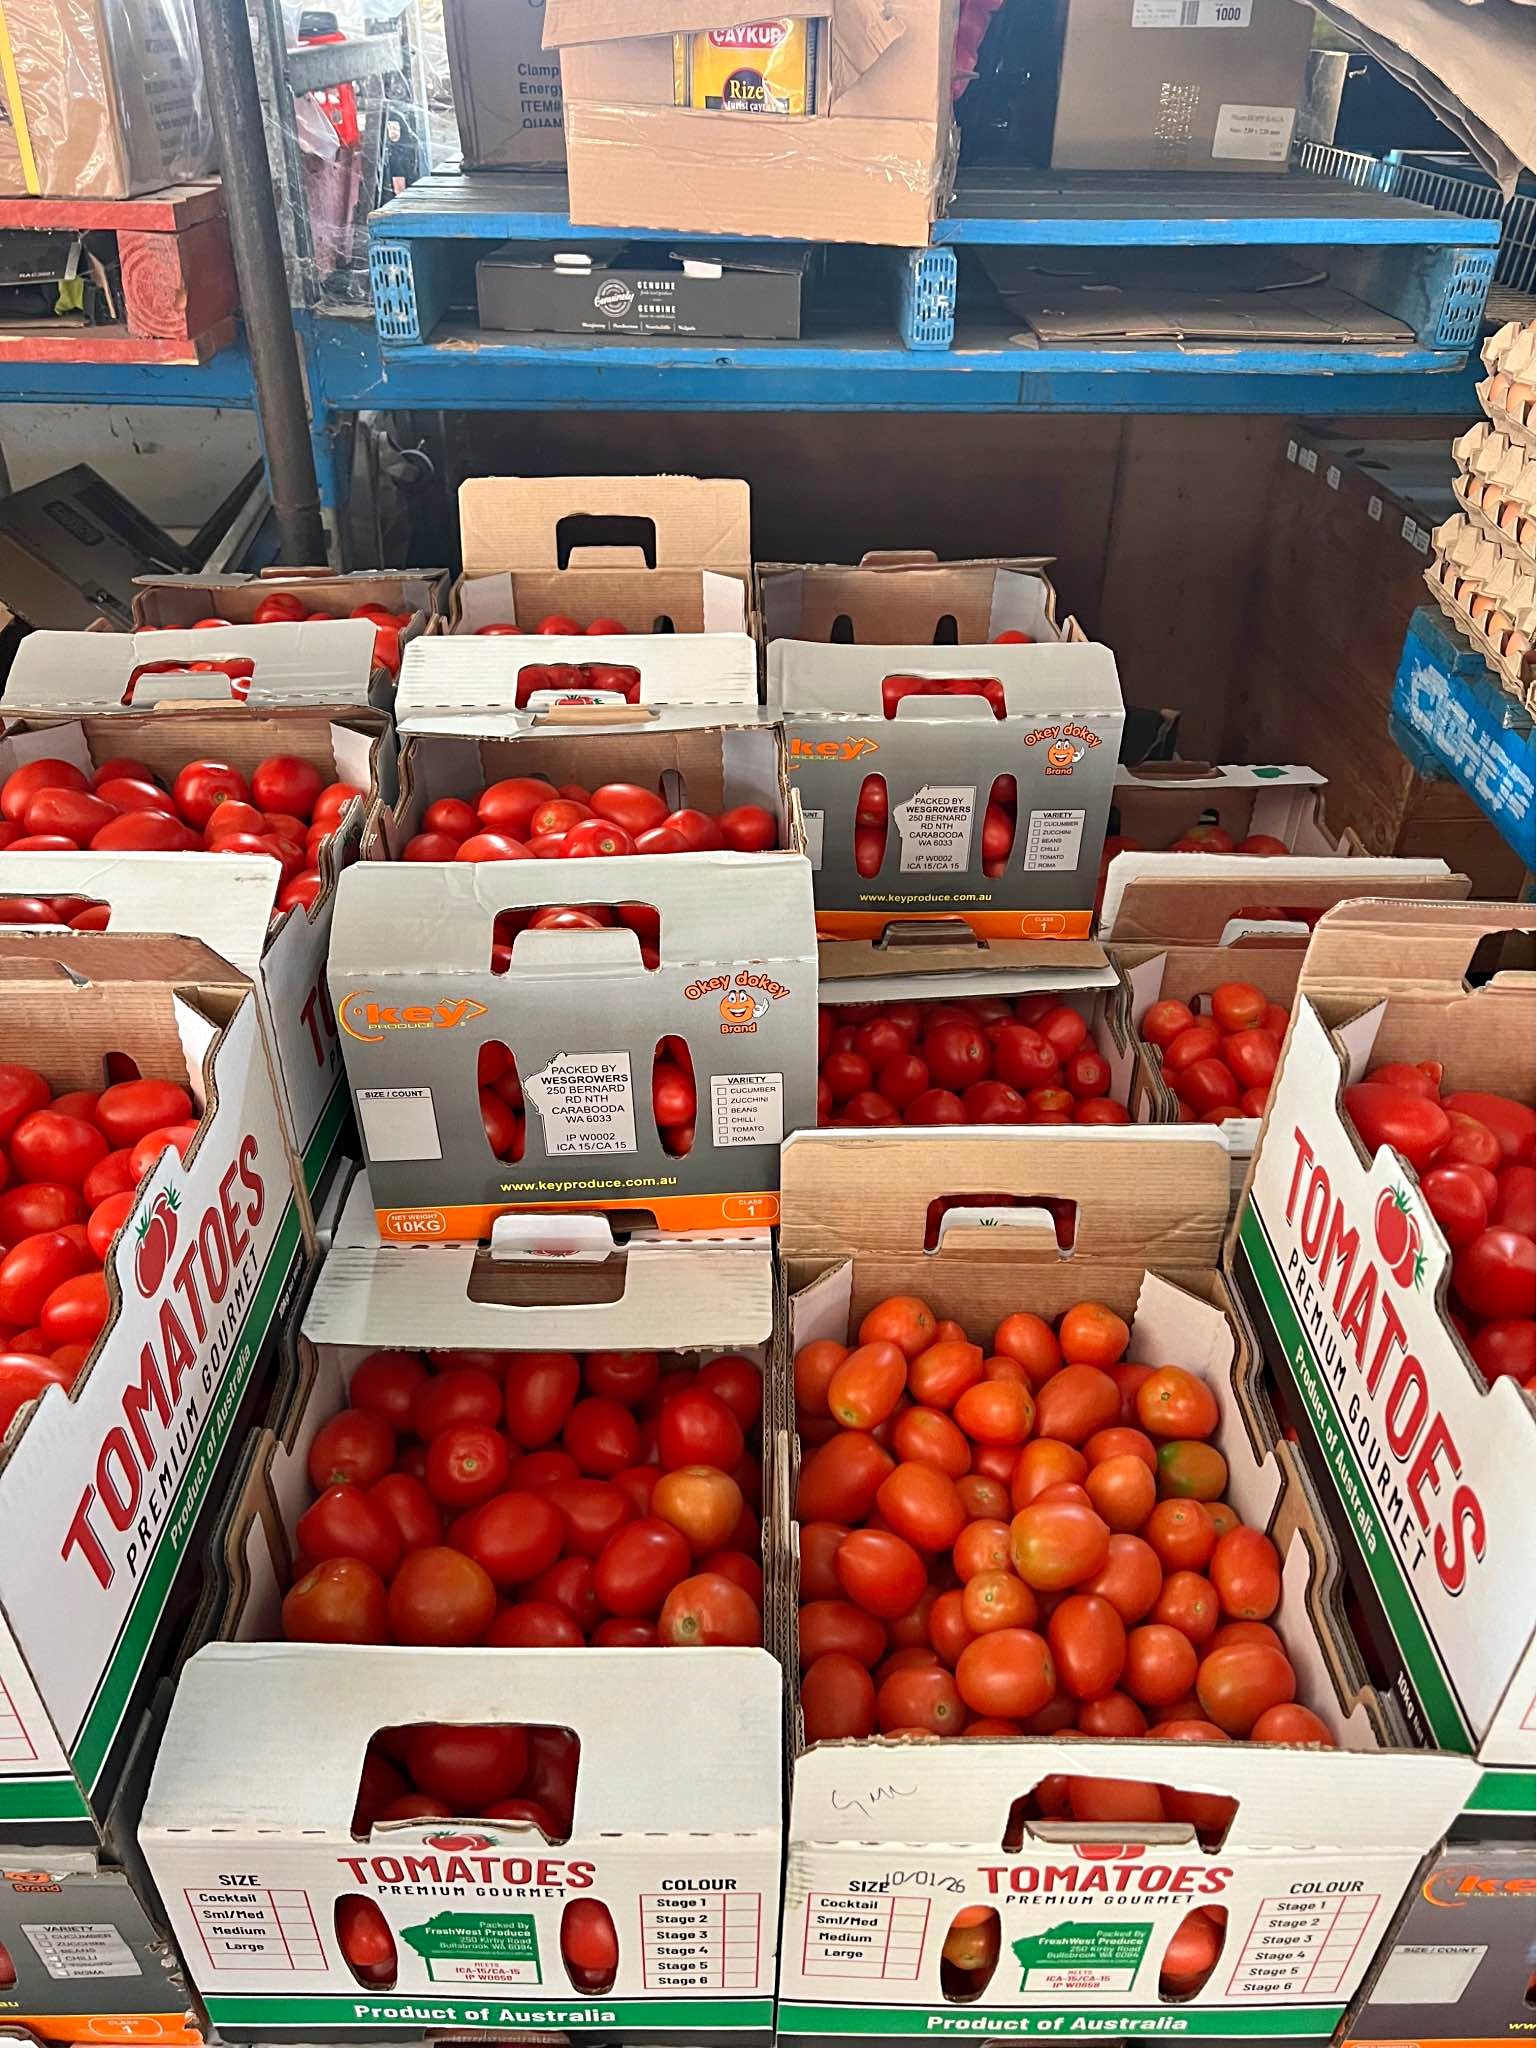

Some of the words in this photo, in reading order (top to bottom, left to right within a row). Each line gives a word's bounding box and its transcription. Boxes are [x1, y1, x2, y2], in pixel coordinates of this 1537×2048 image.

[1215, 7, 1241, 21] 1000
[517, 63, 560, 78] Clamp
[729, 79, 764, 99] Rize
[637, 281, 676, 290] GENUINE
[638, 304, 677, 313] GENUINE
[1023, 725, 1060, 746] Okey
[1063, 722, 1103, 748] dokey
[790, 738, 866, 762] key
[1044, 766, 1074, 776] Brand
[915, 797, 950, 805] PACKED
[906, 806, 971, 814] WESGROWERS
[908, 814, 923, 822] 250
[925, 814, 967, 822] BERNARD
[920, 822, 934, 830] RD
[935, 822, 953, 830] NTH
[909, 831, 964, 839] CARABOODA
[859, 893, 993, 904] www.keyproduce.com.au
[1040, 922, 1047, 932] 1
[684, 975, 731, 1001] Okey
[735, 970, 791, 1001] dokey
[365, 1001, 470, 1030] key
[720, 1021, 758, 1034] Brand
[551, 1065, 598, 1075] PACKED
[601, 1064, 617, 1073] BY
[540, 1073, 629, 1085] WESGROWERS
[727, 1076, 767, 1085] VARIETY
[364, 1091, 385, 1099] SIZE
[393, 1090, 424, 1098] COUNT
[546, 1086, 566, 1095] 250
[569, 1084, 625, 1094] BERNARD
[730, 1086, 777, 1095] CUCUMBER
[565, 1095, 582, 1104] RD
[585, 1094, 609, 1103] NTH
[730, 1096, 769, 1104] ZUCCHINI
[551, 1104, 625, 1115] CARABOODA
[730, 1106, 758, 1114] BEANS
[565, 1115, 585, 1124] WA
[586, 1114, 612, 1123] 6033
[731, 1125, 765, 1133] TOMATO
[579, 1132, 616, 1141] W0002
[731, 1135, 756, 1143] ROMA
[556, 1143, 576, 1151] ICA
[578, 1142, 612, 1151] 15/CA
[614, 1141, 627, 1149] 15
[500, 1176, 678, 1192] www.keyproduce.com.au
[747, 1205, 755, 1217] 1
[407, 1213, 438, 1221] WEIGHT
[392, 1220, 441, 1233] 10KG
[61, 1134, 266, 1591] TOMATOES
[1281, 1125, 1487, 1598] TOMATOES
[126, 1396, 200, 1578] PREMIUM
[202, 1243, 260, 1395] GOURMET
[1288, 1247, 1347, 1392] PREMIUM
[1348, 1393, 1427, 1573] GOURMET
[170, 1454, 208, 1551] Product
[206, 1424, 218, 1457] of
[214, 1343, 251, 1436] Australia
[1295, 1344, 1328, 1430] Product
[1325, 1425, 1339, 1452] of
[1334, 1447, 1377, 1555] Australia
[1397, 1670, 1415, 1719] 10kg
[336, 1855, 597, 1889] TOMATOES
[217, 1874, 262, 1886] SIZE
[661, 1878, 737, 1891] COLOUR
[885, 1870, 966, 1894] 10/01/26
[976, 1865, 1235, 1894] TOMATOES
[13, 1883, 62, 1893] Brand
[377, 1885, 465, 1896] PREMIUM
[476, 1887, 567, 1898] GOURMET
[848, 1880, 890, 1893] SIZE
[1289, 1880, 1365, 1895] COLOUR
[199, 1893, 257, 1903] Cocktail
[656, 1898, 697, 1909] Stage
[700, 1898, 706, 1907] 1
[1005, 1895, 1094, 1905] PREMIUM
[1103, 1894, 1196, 1905] GOURMET
[820, 1898, 878, 1910] Cocktail
[1276, 1902, 1316, 1912] Stage
[1320, 1901, 1327, 1910] 1
[202, 1910, 265, 1920] Sml/Med
[656, 1915, 696, 1925] Stage
[698, 1914, 709, 1923] 2
[479, 1922, 516, 1930] Packed
[516, 1922, 530, 1931] By
[816, 1915, 878, 1927] Sml/Med
[1268, 1919, 1308, 1929] Stage
[1310, 1918, 1321, 1927] 2
[212, 1926, 266, 1936] Medium
[424, 1927, 483, 1936] FreshWest
[485, 1928, 531, 1937] Produce
[656, 1931, 696, 1941] Stage
[699, 1930, 708, 1939] 3
[1096, 1930, 1132, 1938] Packed
[1133, 1931, 1147, 1939] By
[507, 1937, 532, 1945] Road
[818, 1932, 873, 1943] Medium
[1038, 1937, 1096, 1946] FreshWest
[1097, 1938, 1144, 1946] Produce
[1261, 1936, 1301, 1946] Stage
[1303, 1934, 1313, 1943] 3
[225, 1941, 265, 1953] Large
[656, 1946, 696, 1957] Stage
[698, 1946, 709, 1955] 4
[823, 1948, 864, 1960] Large
[1255, 1952, 1294, 1962] Stage
[1297, 1950, 1306, 1959] 4
[455, 1967, 521, 1976] ICA-15/CA-15
[657, 1962, 696, 1972] Stage
[699, 1961, 708, 1970] 5
[1248, 1967, 1287, 1977] Stage
[1290, 1966, 1300, 1975] 5
[658, 1977, 696, 1986] Stage
[699, 1976, 708, 1985] 6
[1242, 1983, 1280, 1992] Stage
[1283, 1982, 1293, 1991] 6
[354, 2004, 457, 2021] Product
[464, 2007, 490, 2022] of
[499, 2008, 617, 2023] Australia
[926, 2016, 1029, 2030] Product
[1036, 2017, 1065, 2030] of
[1069, 2016, 1189, 2030] Australia
